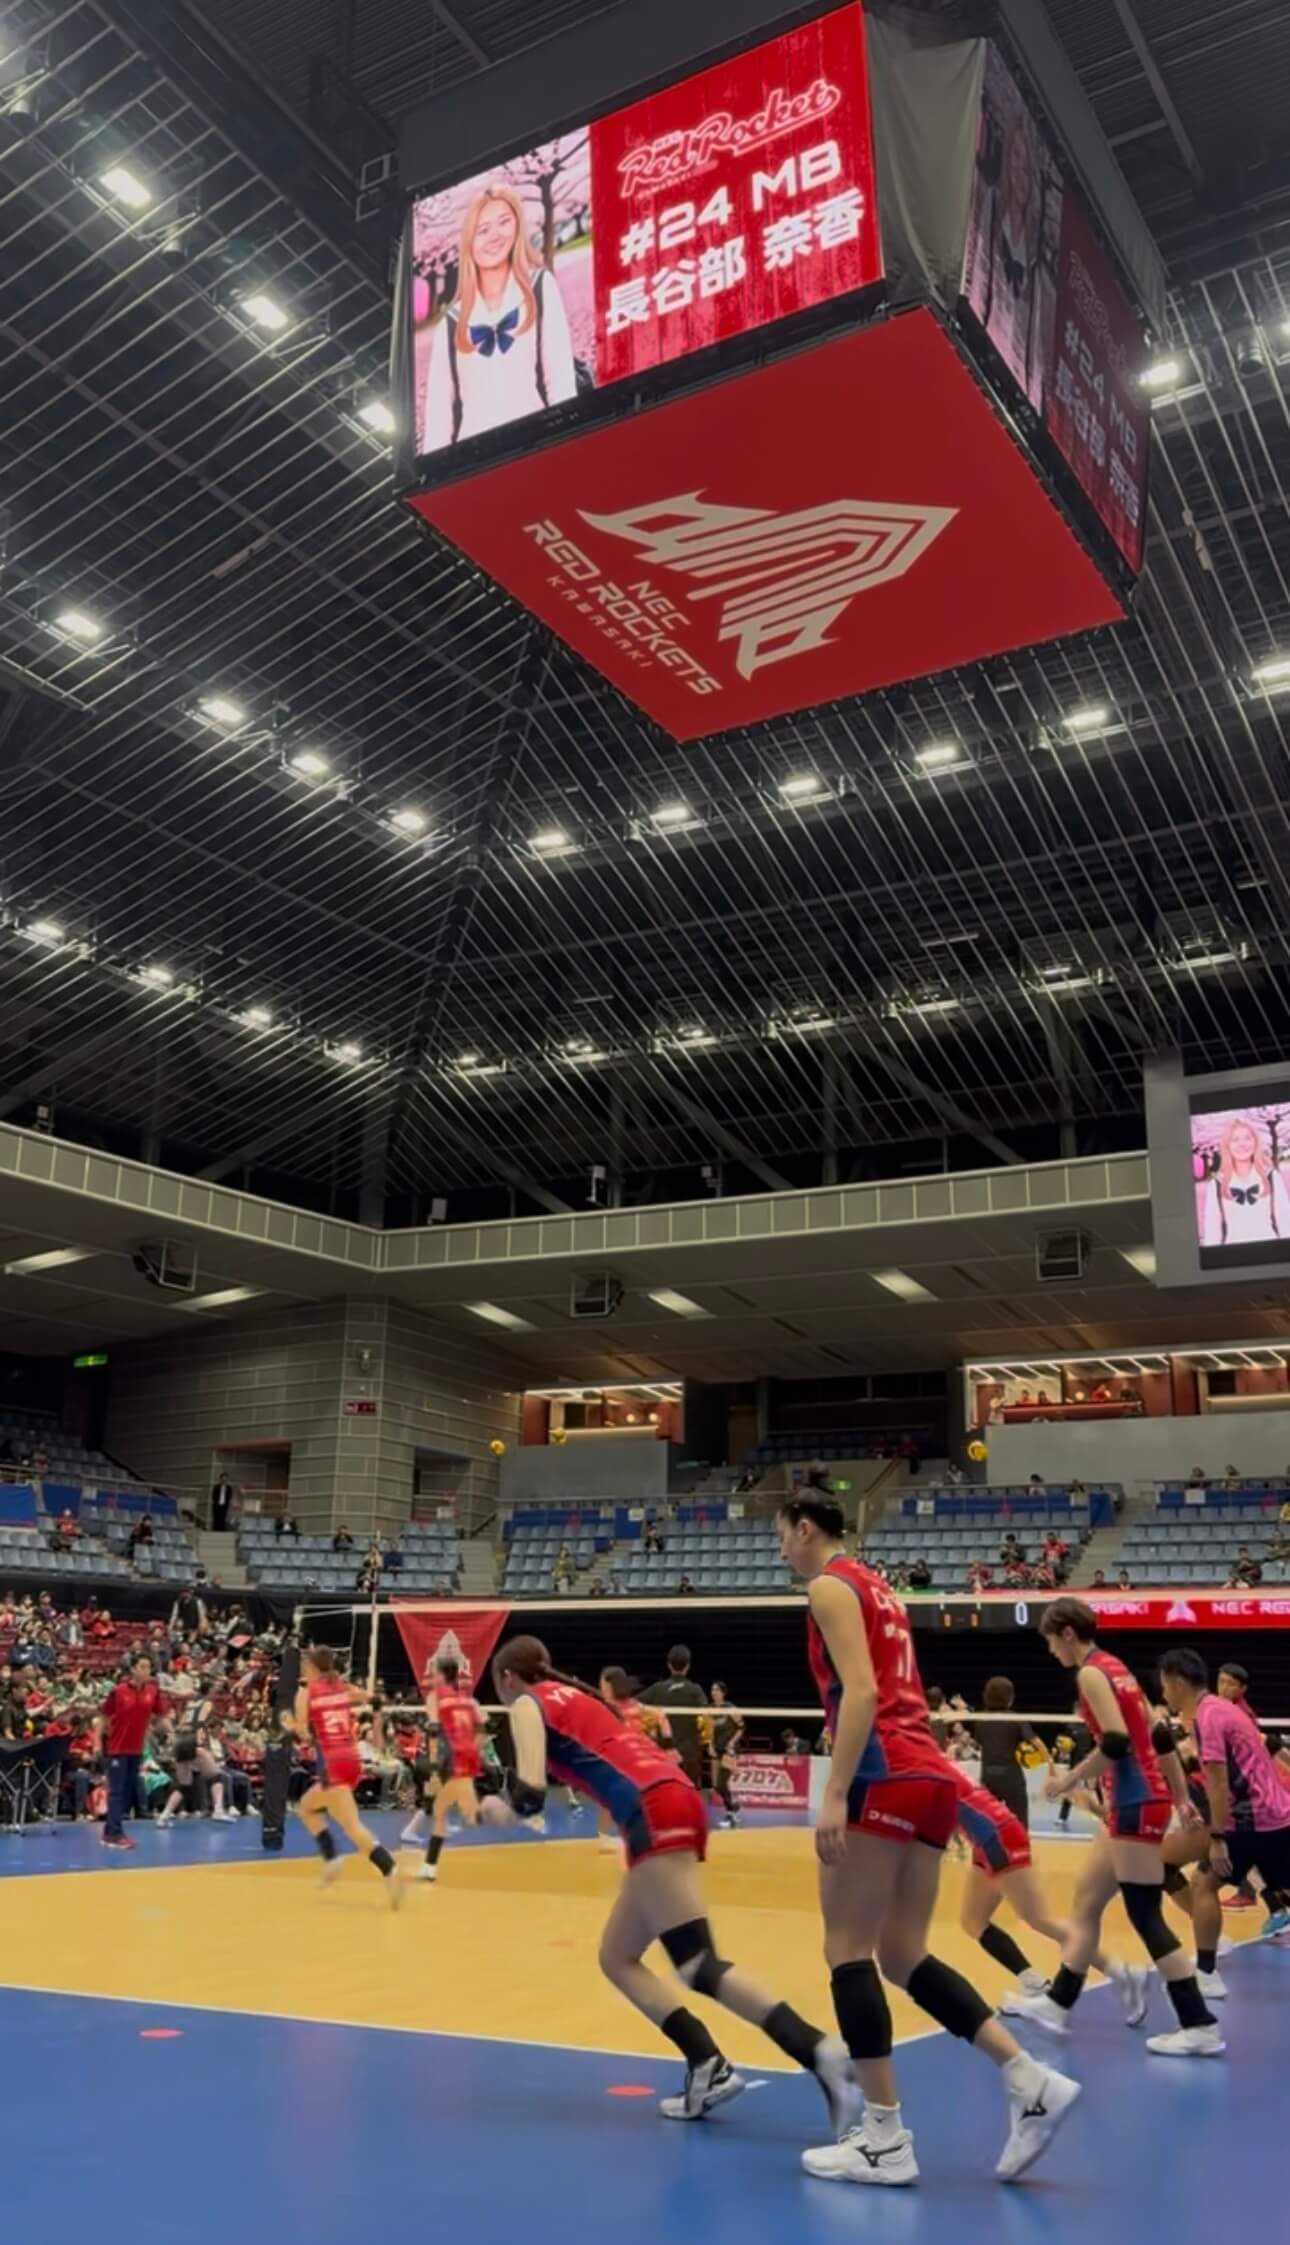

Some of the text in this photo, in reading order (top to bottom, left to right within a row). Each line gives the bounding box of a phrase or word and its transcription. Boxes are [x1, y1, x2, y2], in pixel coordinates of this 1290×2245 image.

[620, 139, 842, 267] #24 MB
[607, 188, 865, 335] 長谷部 奈香
[523, 519, 724, 695] RED ROCKETS
[627, 580, 692, 631] NEC
[1015, 1600, 1029, 1626] 0
[1211, 1602, 1255, 1615] NEC
